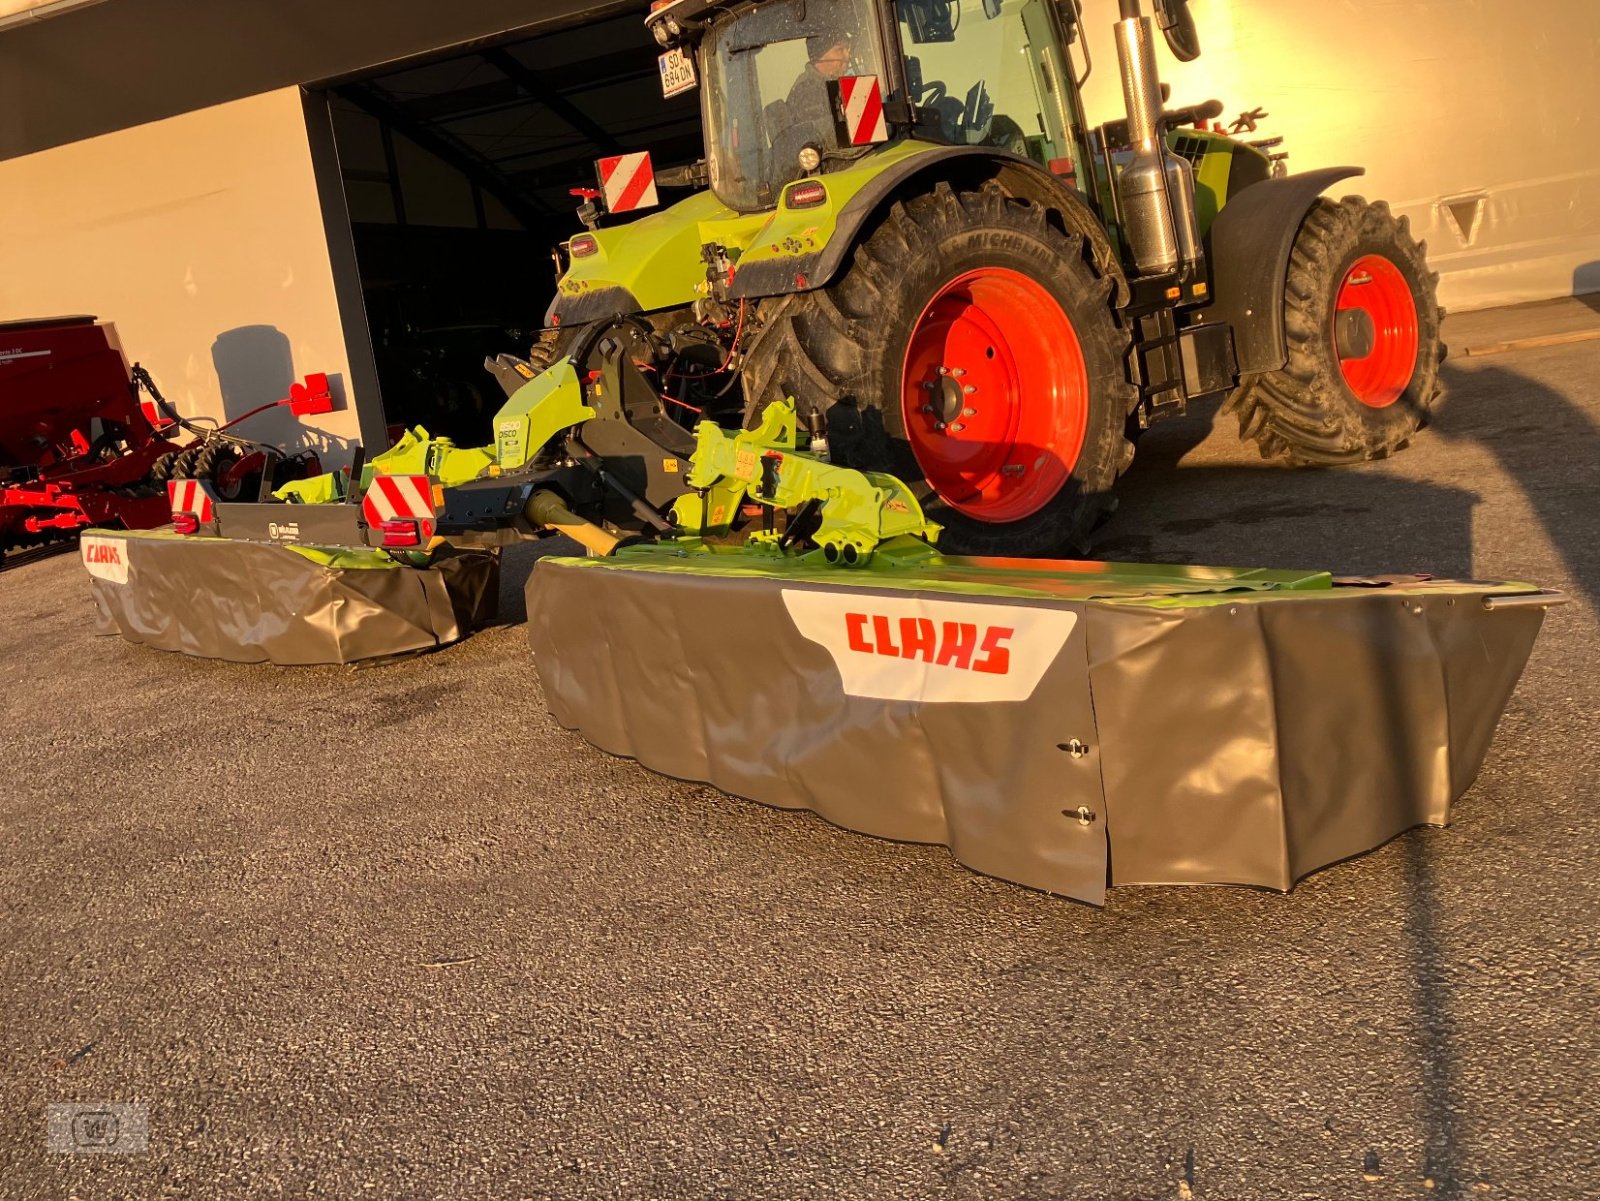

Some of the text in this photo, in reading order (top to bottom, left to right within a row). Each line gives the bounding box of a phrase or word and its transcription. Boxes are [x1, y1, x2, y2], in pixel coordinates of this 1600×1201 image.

[664, 64, 692, 87] 684 DN
[969, 232, 1051, 265] MICHELIN
[499, 430, 517, 438] DISCO
[87, 544, 121, 565] CLAAS
[845, 612, 1015, 675] CLAAS
